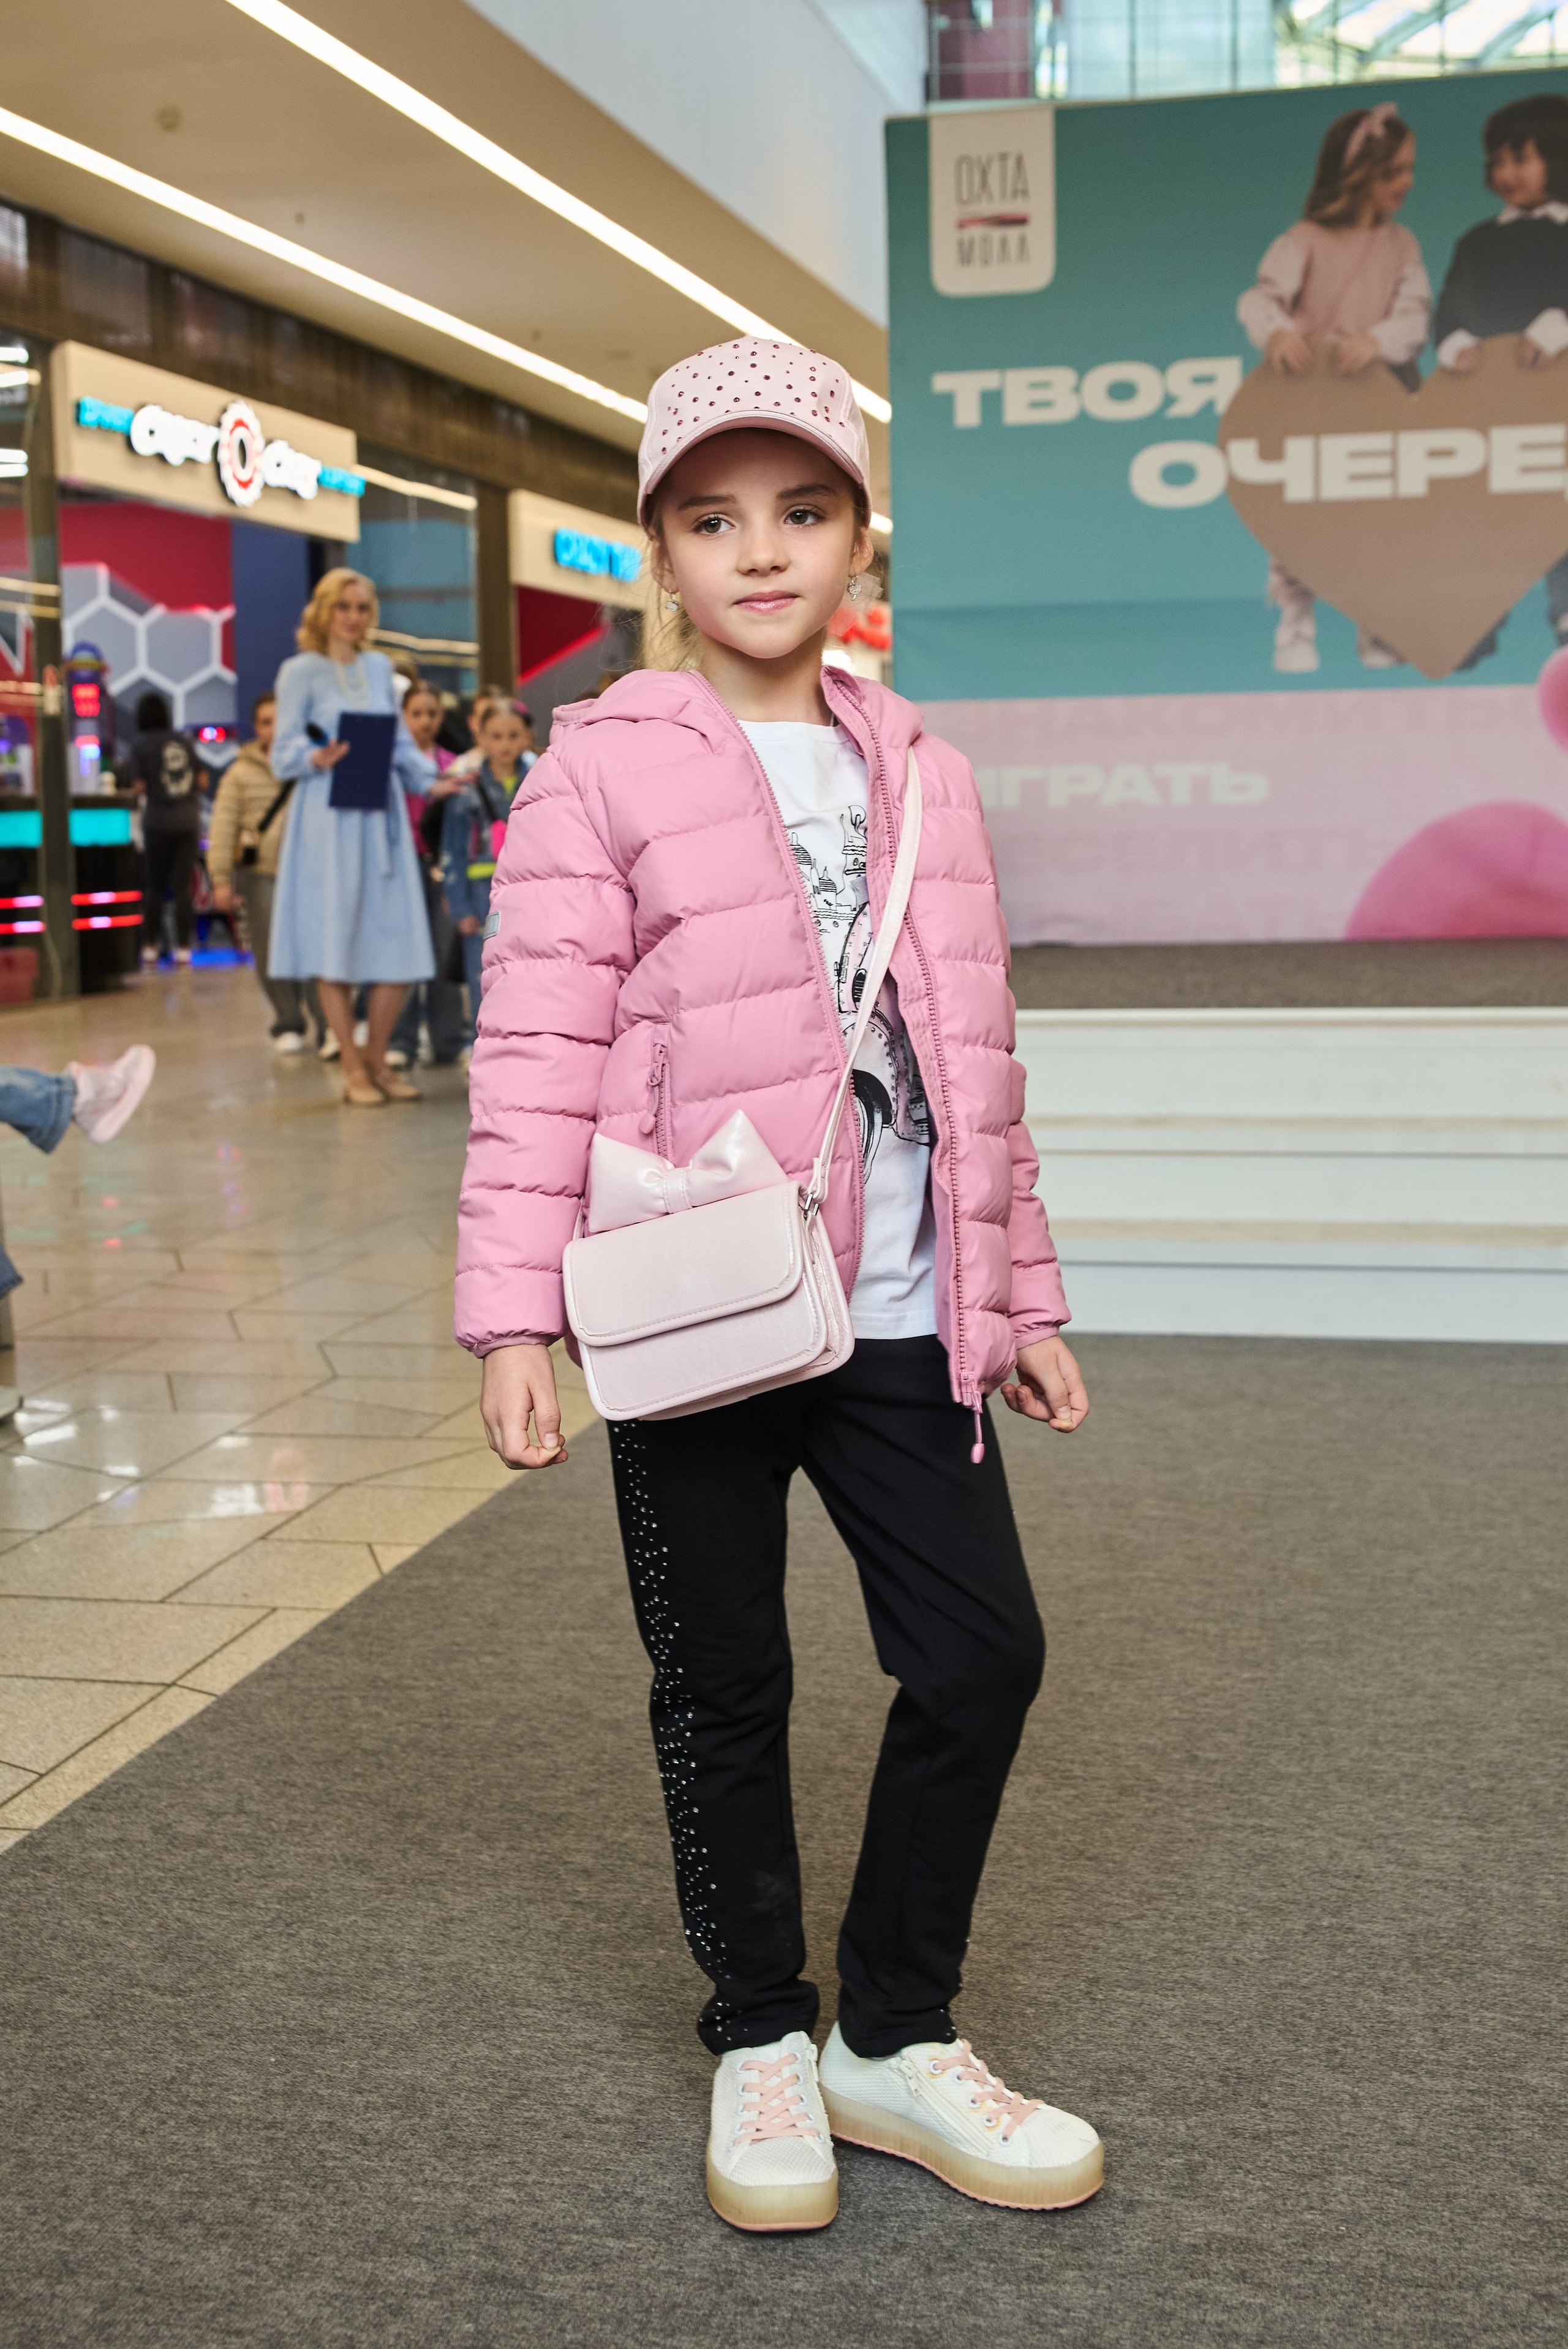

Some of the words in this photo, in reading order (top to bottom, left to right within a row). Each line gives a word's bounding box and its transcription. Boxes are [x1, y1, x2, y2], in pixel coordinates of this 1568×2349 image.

[954, 152, 1030, 207] ОХТА
[932, 356, 1242, 428] ТВОЯ
[1129, 423, 1568, 508] ОЧЕРЕ
